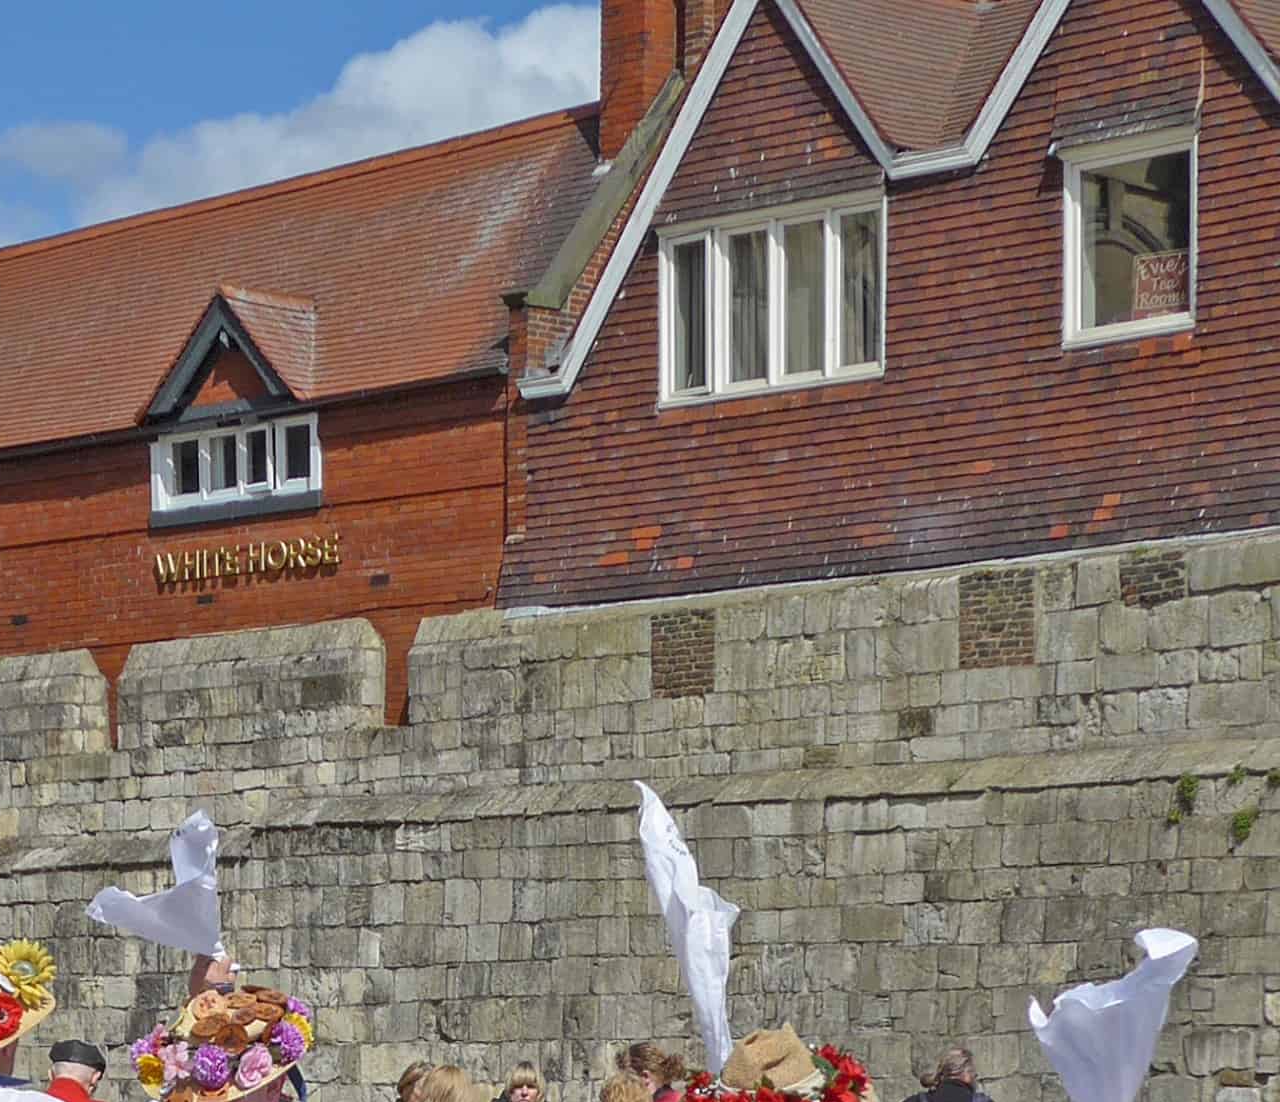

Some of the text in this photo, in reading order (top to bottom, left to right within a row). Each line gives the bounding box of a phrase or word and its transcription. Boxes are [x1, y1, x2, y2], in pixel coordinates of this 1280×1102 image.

[1151, 277, 1180, 291] Tea
[156, 532, 341, 583] WHITE HORSE
